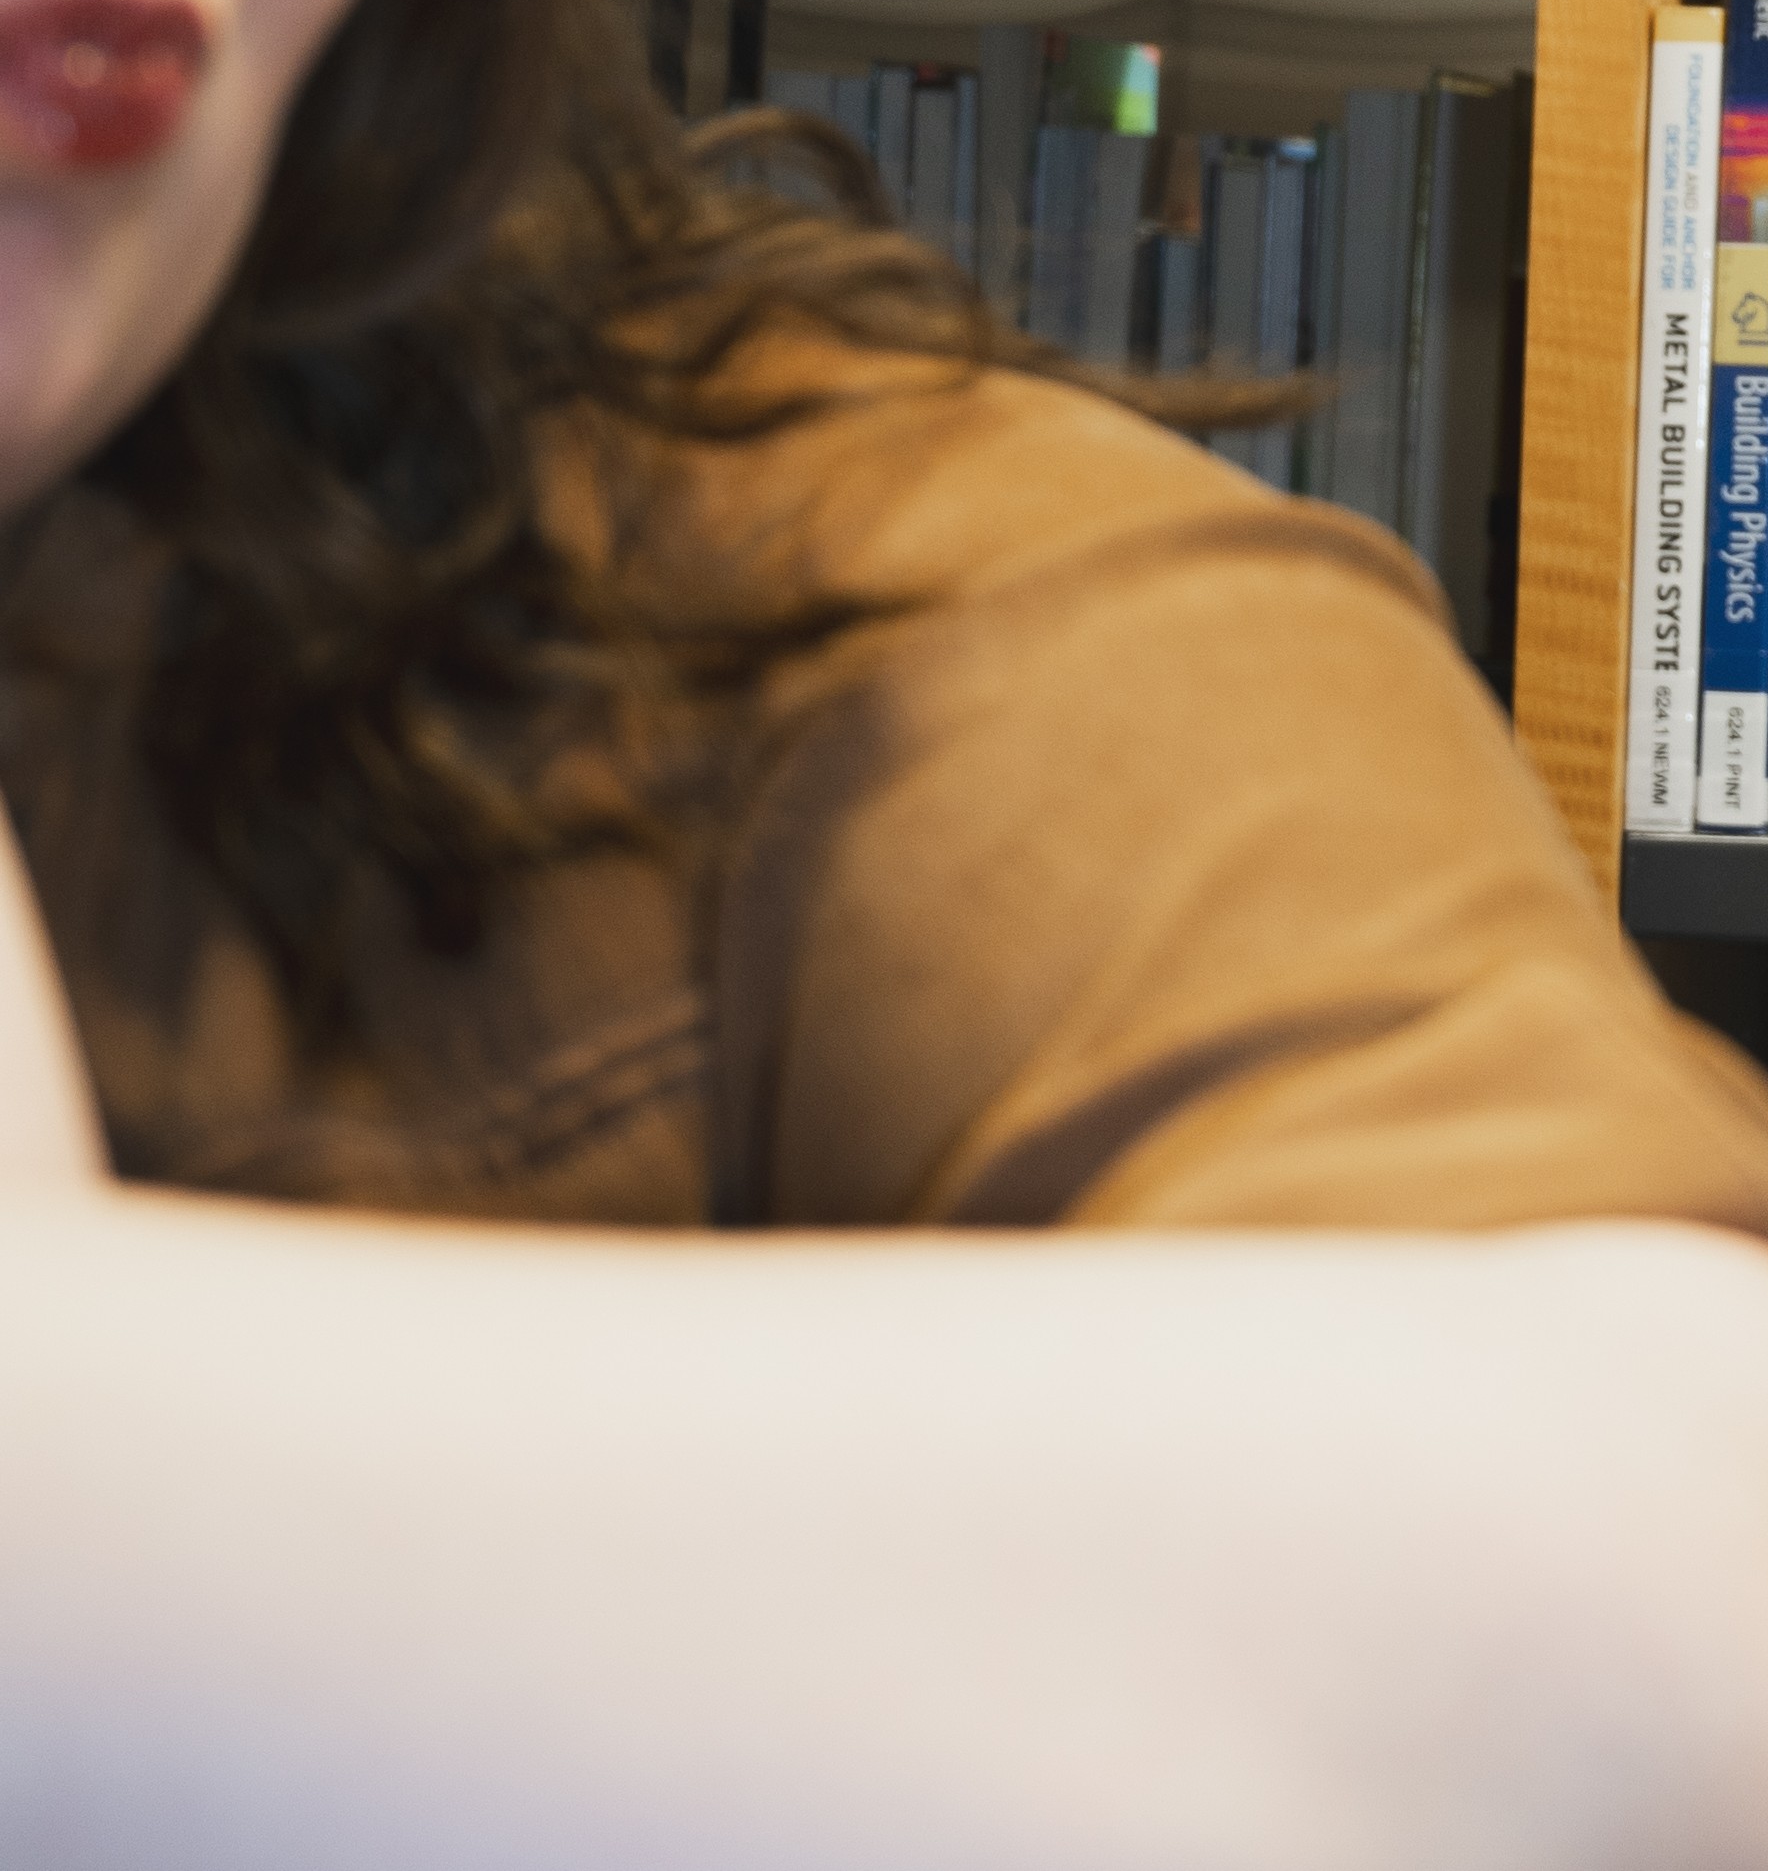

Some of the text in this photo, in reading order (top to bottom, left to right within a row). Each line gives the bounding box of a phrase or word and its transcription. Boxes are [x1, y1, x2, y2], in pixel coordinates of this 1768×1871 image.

[1661, 124, 1682, 291] DESIGN GUIDE FOR
[1683, 171, 1700, 213] AND
[1663, 312, 1690, 414] METAL
[1657, 423, 1688, 574] BUILDING
[1717, 510, 1768, 624] Physics
[1651, 741, 1671, 807] NEWM
[1724, 763, 1743, 810] PINT
